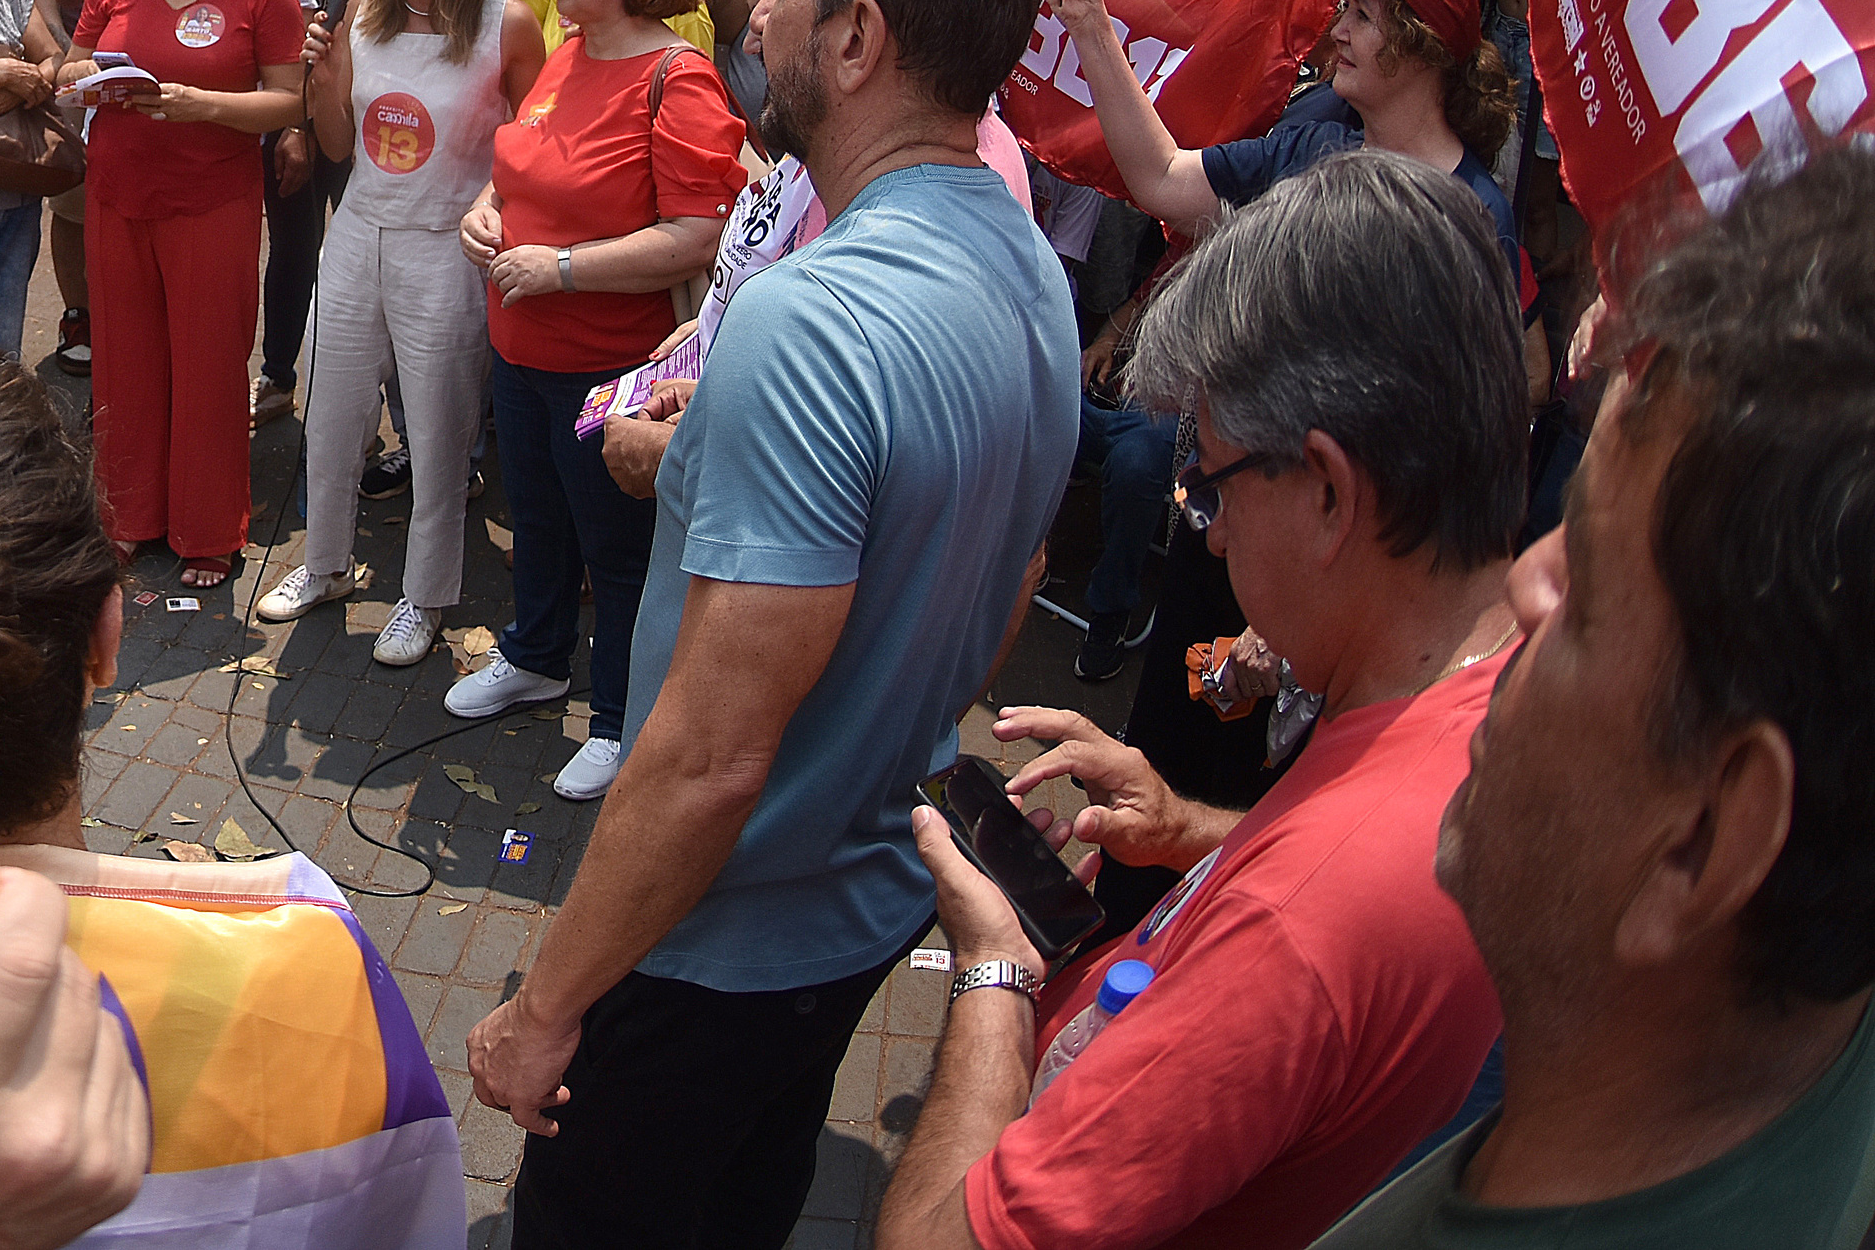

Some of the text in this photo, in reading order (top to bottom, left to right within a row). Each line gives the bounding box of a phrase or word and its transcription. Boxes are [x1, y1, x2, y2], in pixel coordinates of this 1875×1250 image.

[1594, 12, 1607, 36] A
[1600, 25, 1647, 146] VEREADOR
[376, 125, 419, 171] 13
[735, 244, 753, 261] ZERO
